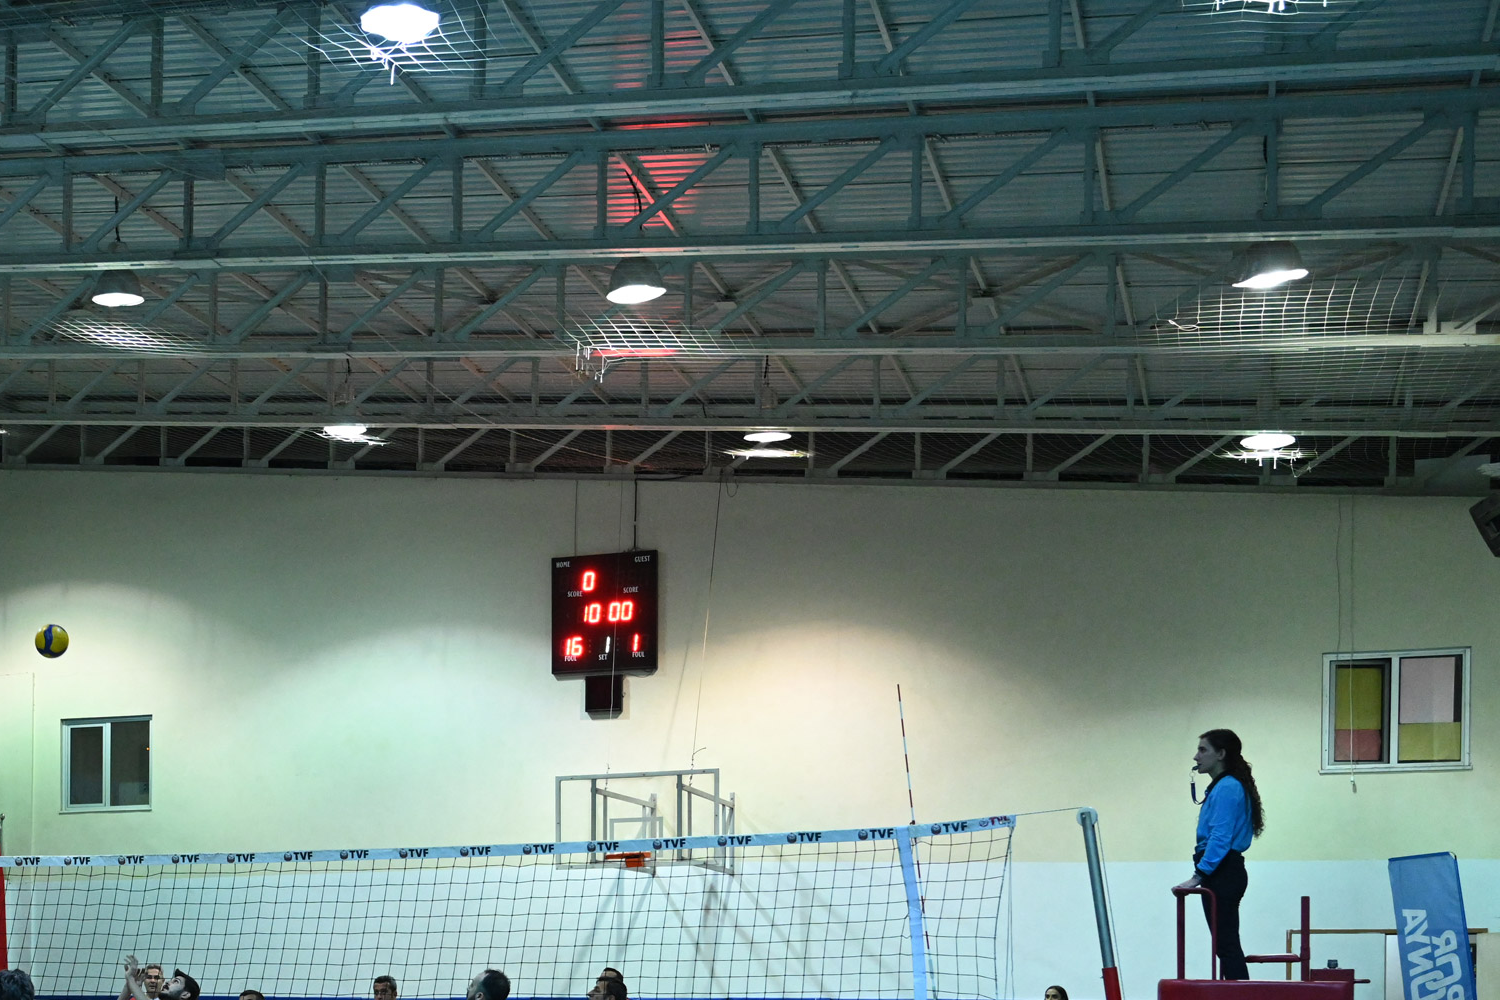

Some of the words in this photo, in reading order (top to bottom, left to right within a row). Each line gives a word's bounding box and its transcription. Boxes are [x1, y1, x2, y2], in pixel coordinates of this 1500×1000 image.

[582, 571, 596, 591] 0
[565, 636, 583, 656] 16
[605, 636, 611, 653] 1
[633, 633, 639, 651] 1
[23, 857, 40, 866] TVF
[73, 857, 90, 865] TVF
[126, 856, 144, 864] TVF
[179, 854, 199, 863] TVF
[236, 853, 255, 862] TVF
[293, 851, 313, 861] TVF
[350, 850, 369, 859] TVF
[408, 849, 428, 858] TVF
[470, 846, 491, 856] TVF
[533, 844, 554, 854] TVF
[600, 842, 619, 851] TVF
[663, 839, 686, 848] TVF
[728, 836, 751, 846] TVF
[798, 832, 822, 842] TVF
[870, 829, 894, 839] TVF
[943, 822, 967, 833] TVF
